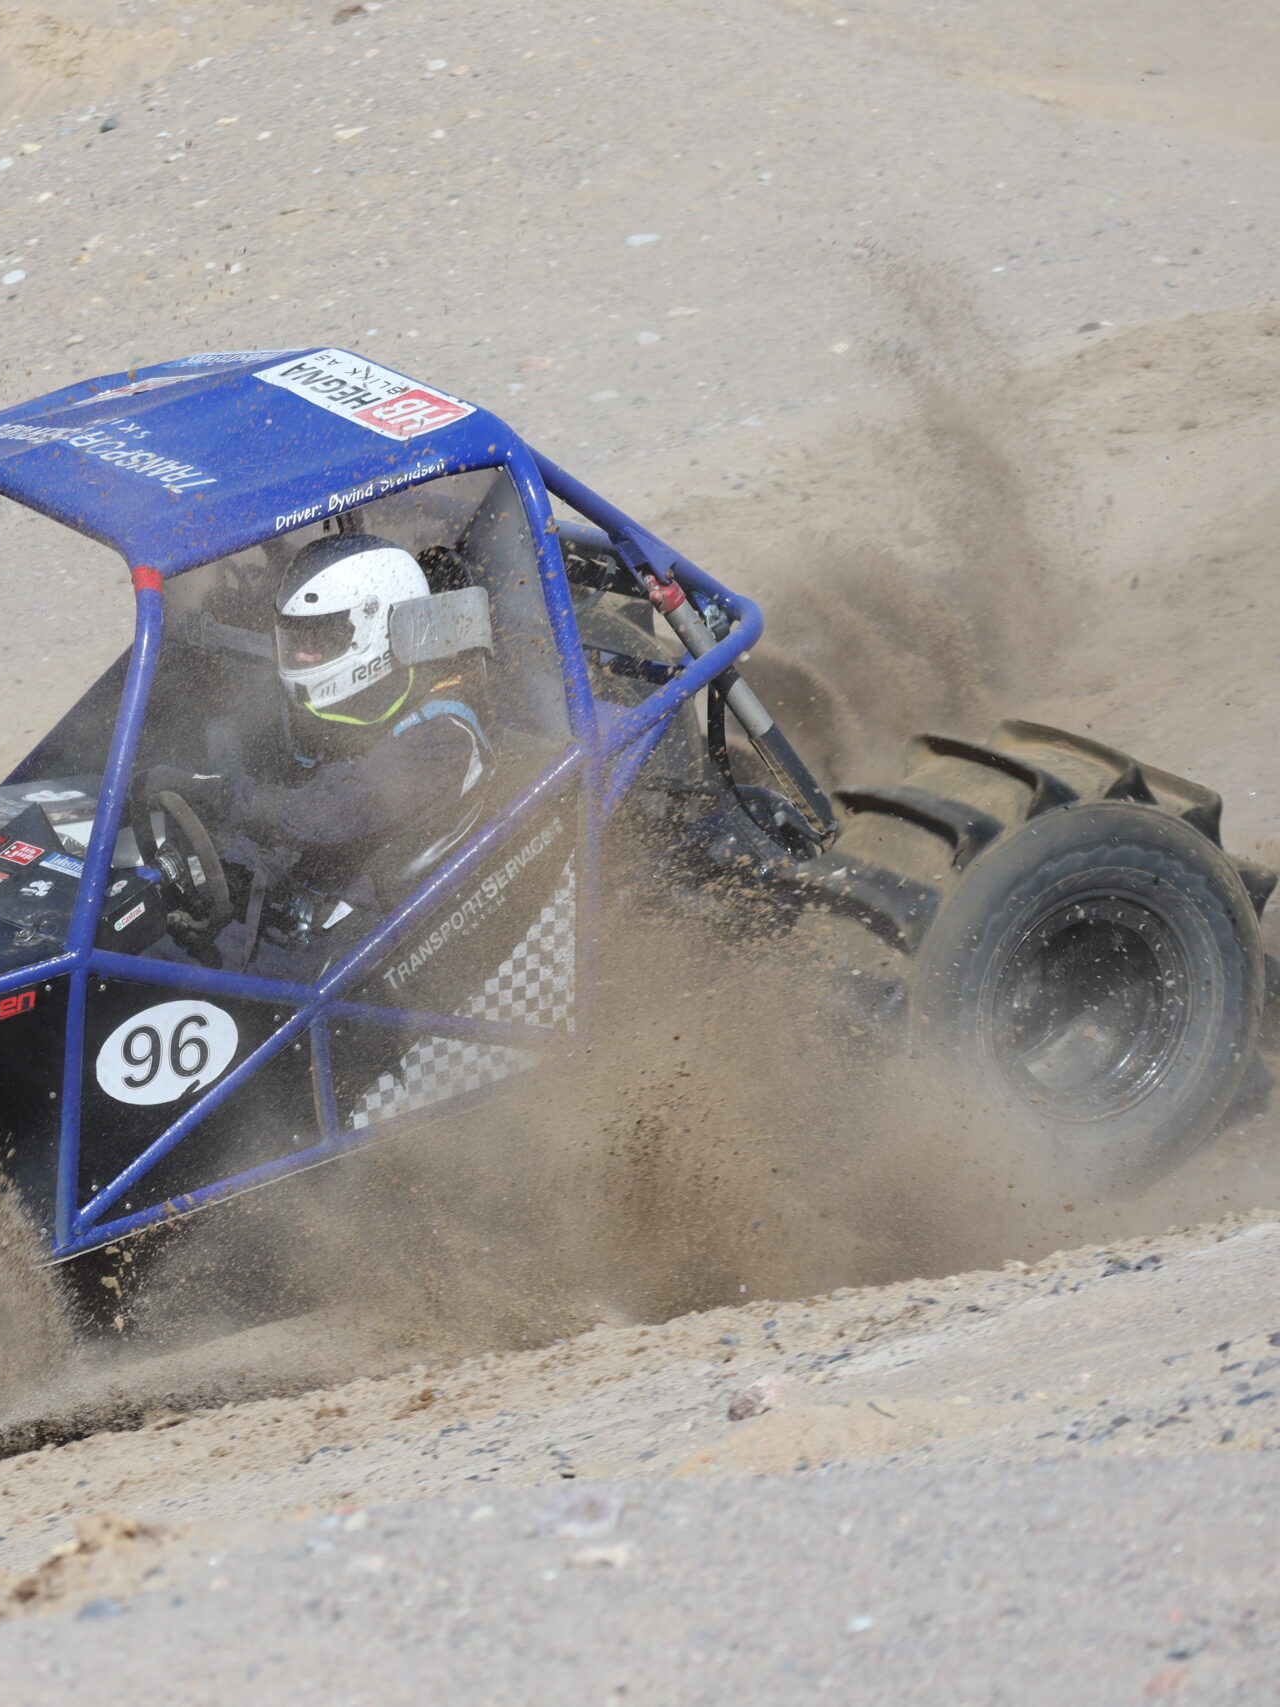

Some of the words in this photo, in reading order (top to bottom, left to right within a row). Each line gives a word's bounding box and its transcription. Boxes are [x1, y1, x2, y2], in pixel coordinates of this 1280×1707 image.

[279, 362, 382, 410] HEGNA
[371, 398, 456, 431] HB
[275, 504, 323, 531] Driver:
[328, 484, 373, 513] Øyvind
[380, 458, 446, 492] Svendsen
[121, 1014, 211, 1090] 96
